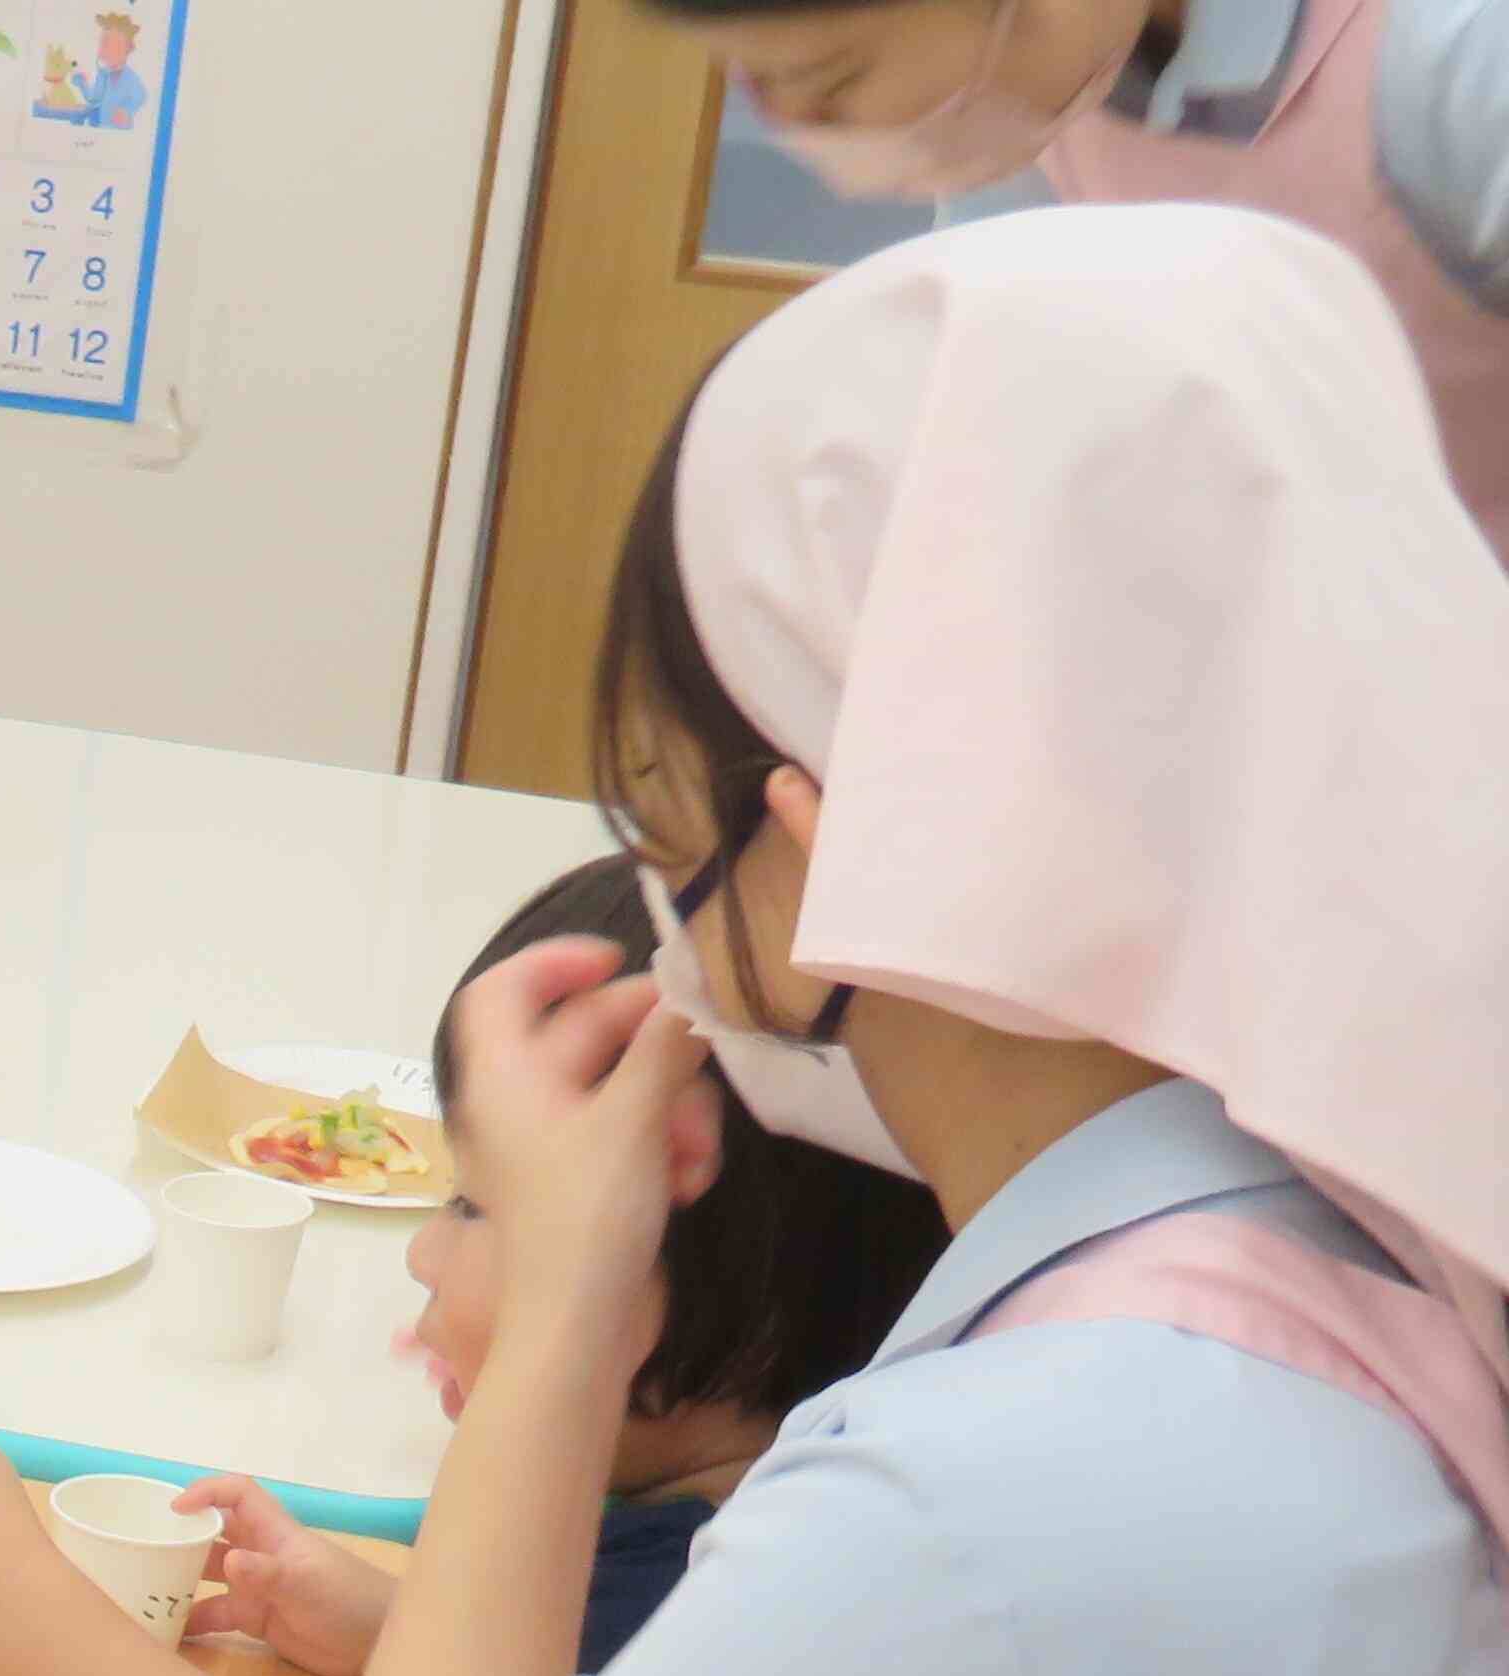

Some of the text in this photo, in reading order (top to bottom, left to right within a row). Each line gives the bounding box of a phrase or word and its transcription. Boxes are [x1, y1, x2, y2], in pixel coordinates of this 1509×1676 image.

[30, 178, 55, 214] 3
[90, 186, 114, 221] 4
[24, 250, 47, 284] 7
[83, 256, 106, 292] 8
[9, 320, 41, 357] 11
[70, 327, 108, 364] 12
